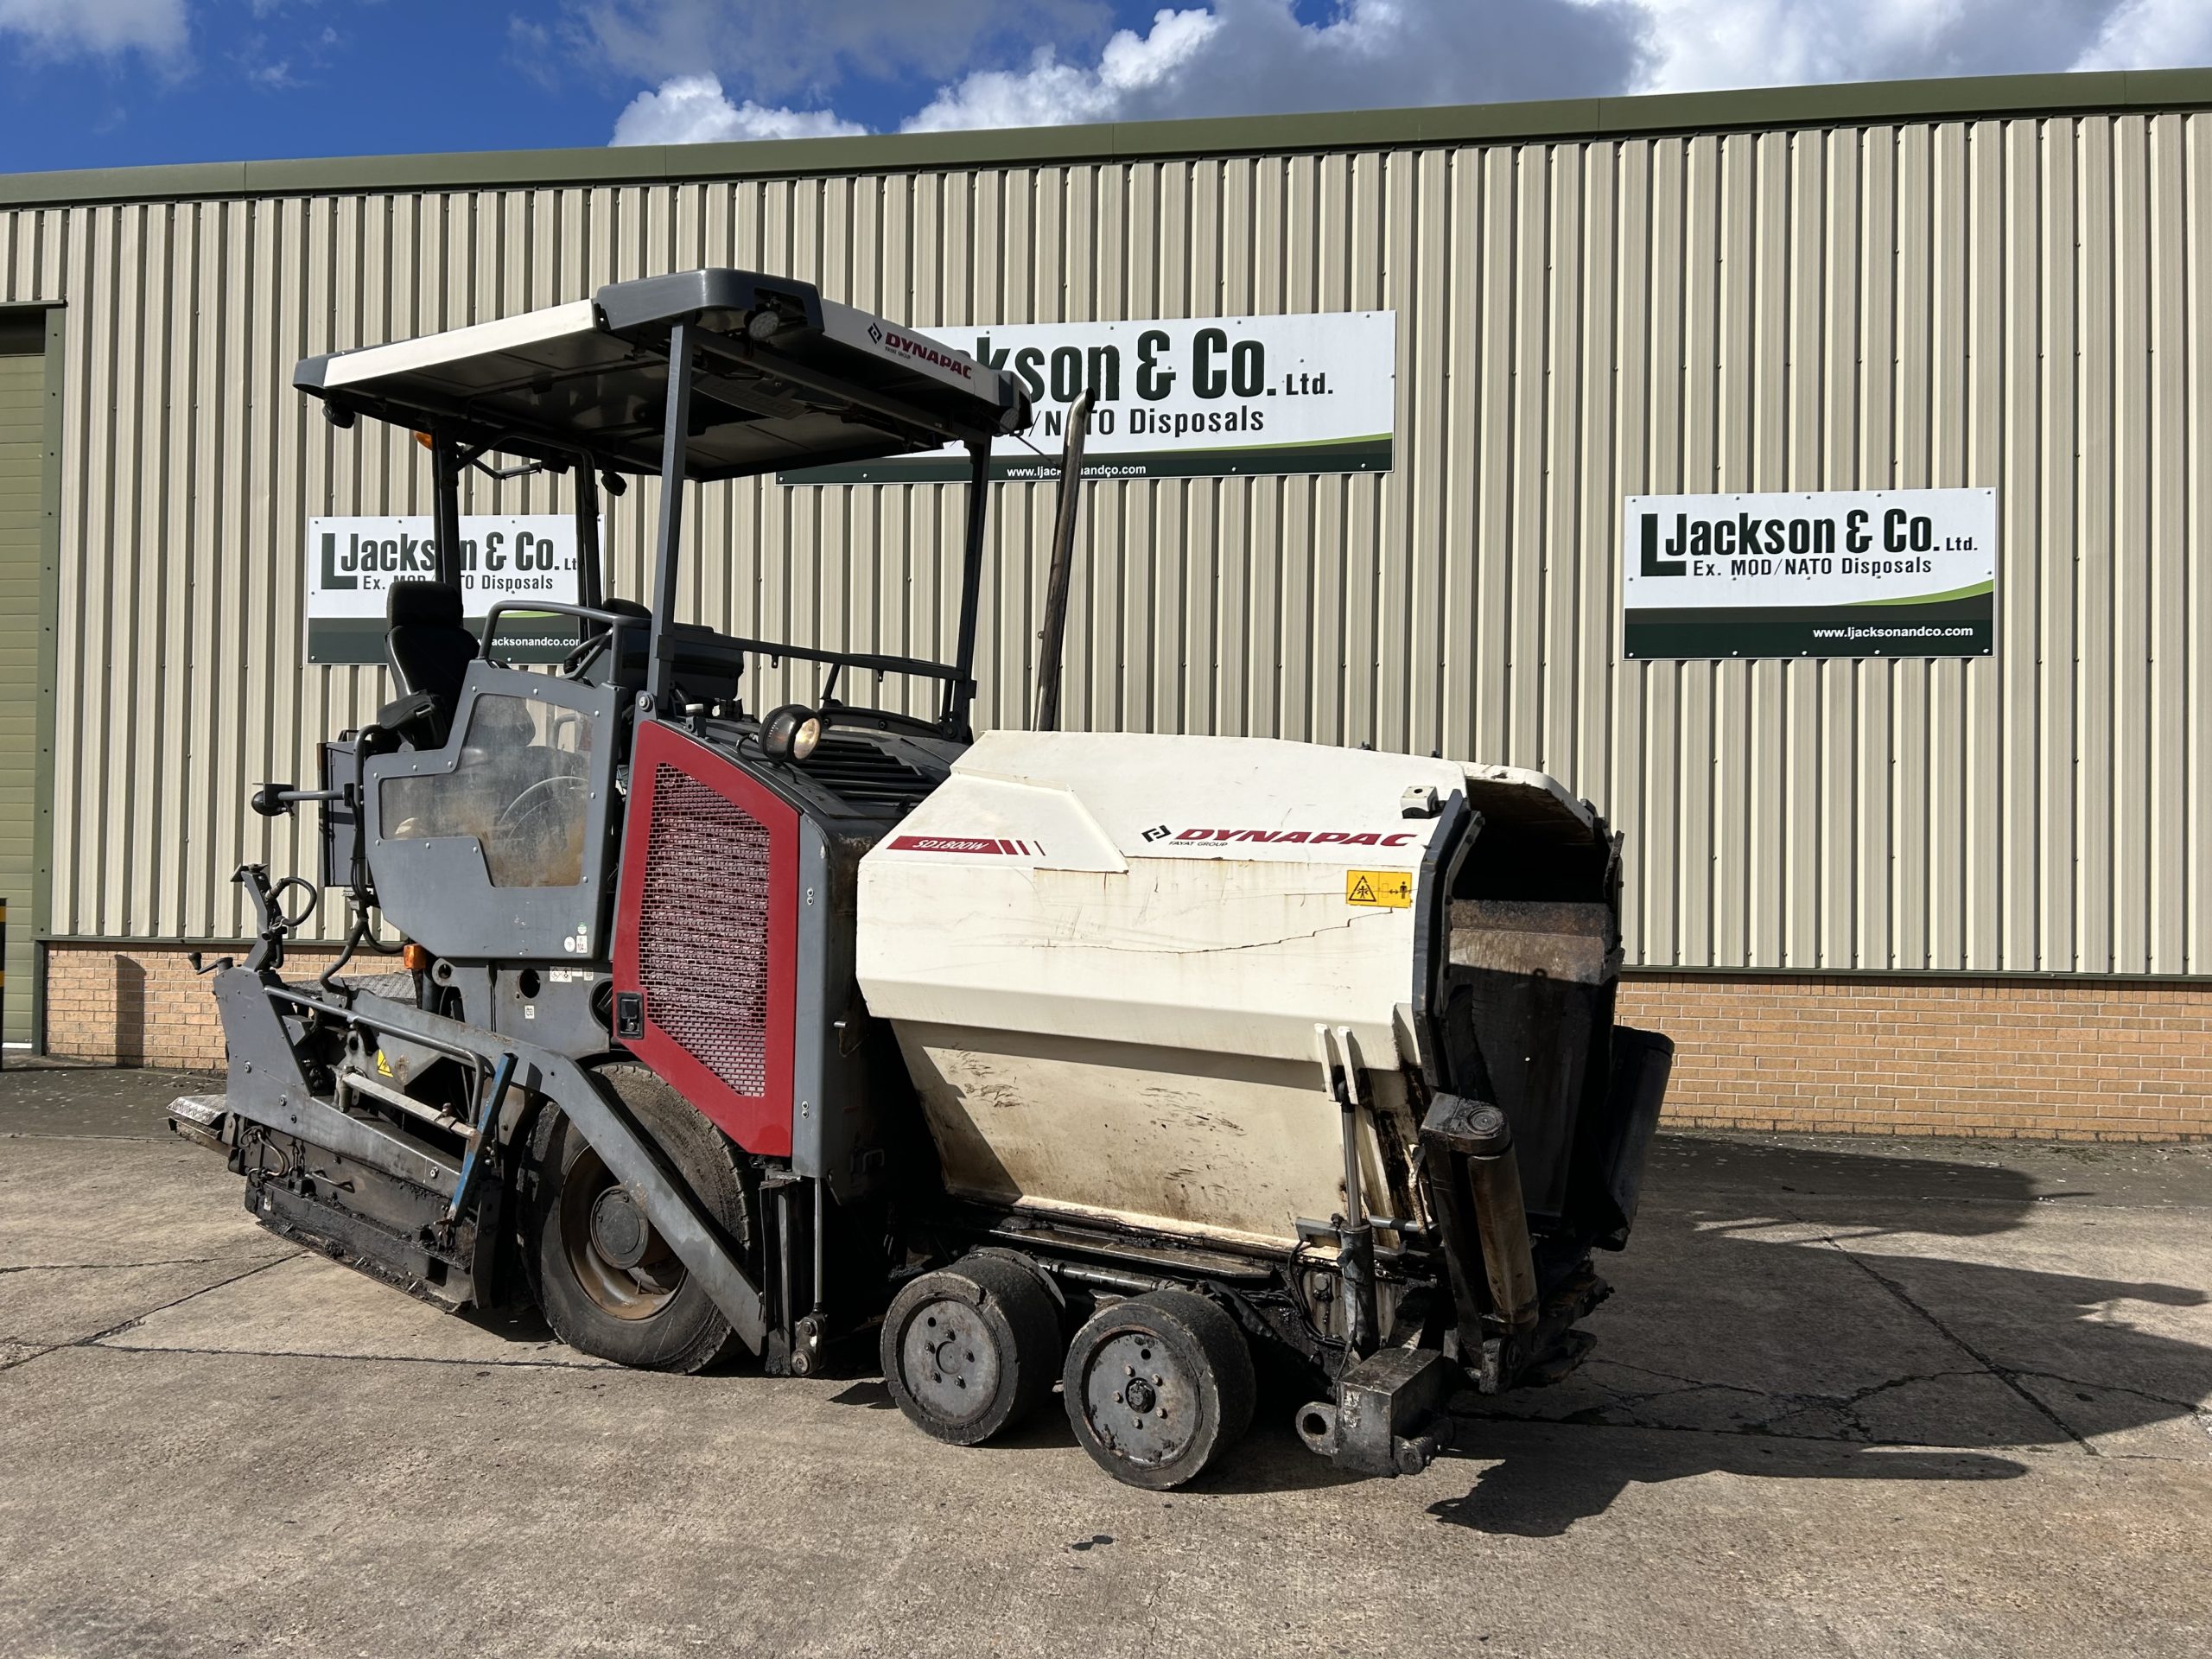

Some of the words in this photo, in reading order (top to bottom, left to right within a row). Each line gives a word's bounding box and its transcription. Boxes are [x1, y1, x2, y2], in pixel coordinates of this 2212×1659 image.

[885, 332, 972, 380] DYNAPAC
[1135, 329, 1177, 402] &
[1192, 327, 1277, 399] Co.
[1286, 372, 1333, 396] Ltd.
[1129, 404, 1264, 437] Disposals
[1846, 508, 1873, 555] &
[1883, 508, 1941, 553] Co.
[1946, 537, 1978, 552] Ltd.
[486, 531, 507, 571] &
[515, 531, 559, 571] Co.
[564, 557, 577, 570] Lt
[1694, 560, 1722, 576] Ex.
[1731, 557, 1832, 576] MOD/NATO
[1841, 556, 1932, 577] Disposals
[363, 575, 385, 590] Ex.
[482, 575, 554, 592] Disposals
[1813, 626, 1974, 640] www.ljacksonandco.com
[912, 839, 989, 850] SD1800W
[1174, 829, 1417, 846] DYNAPAC
